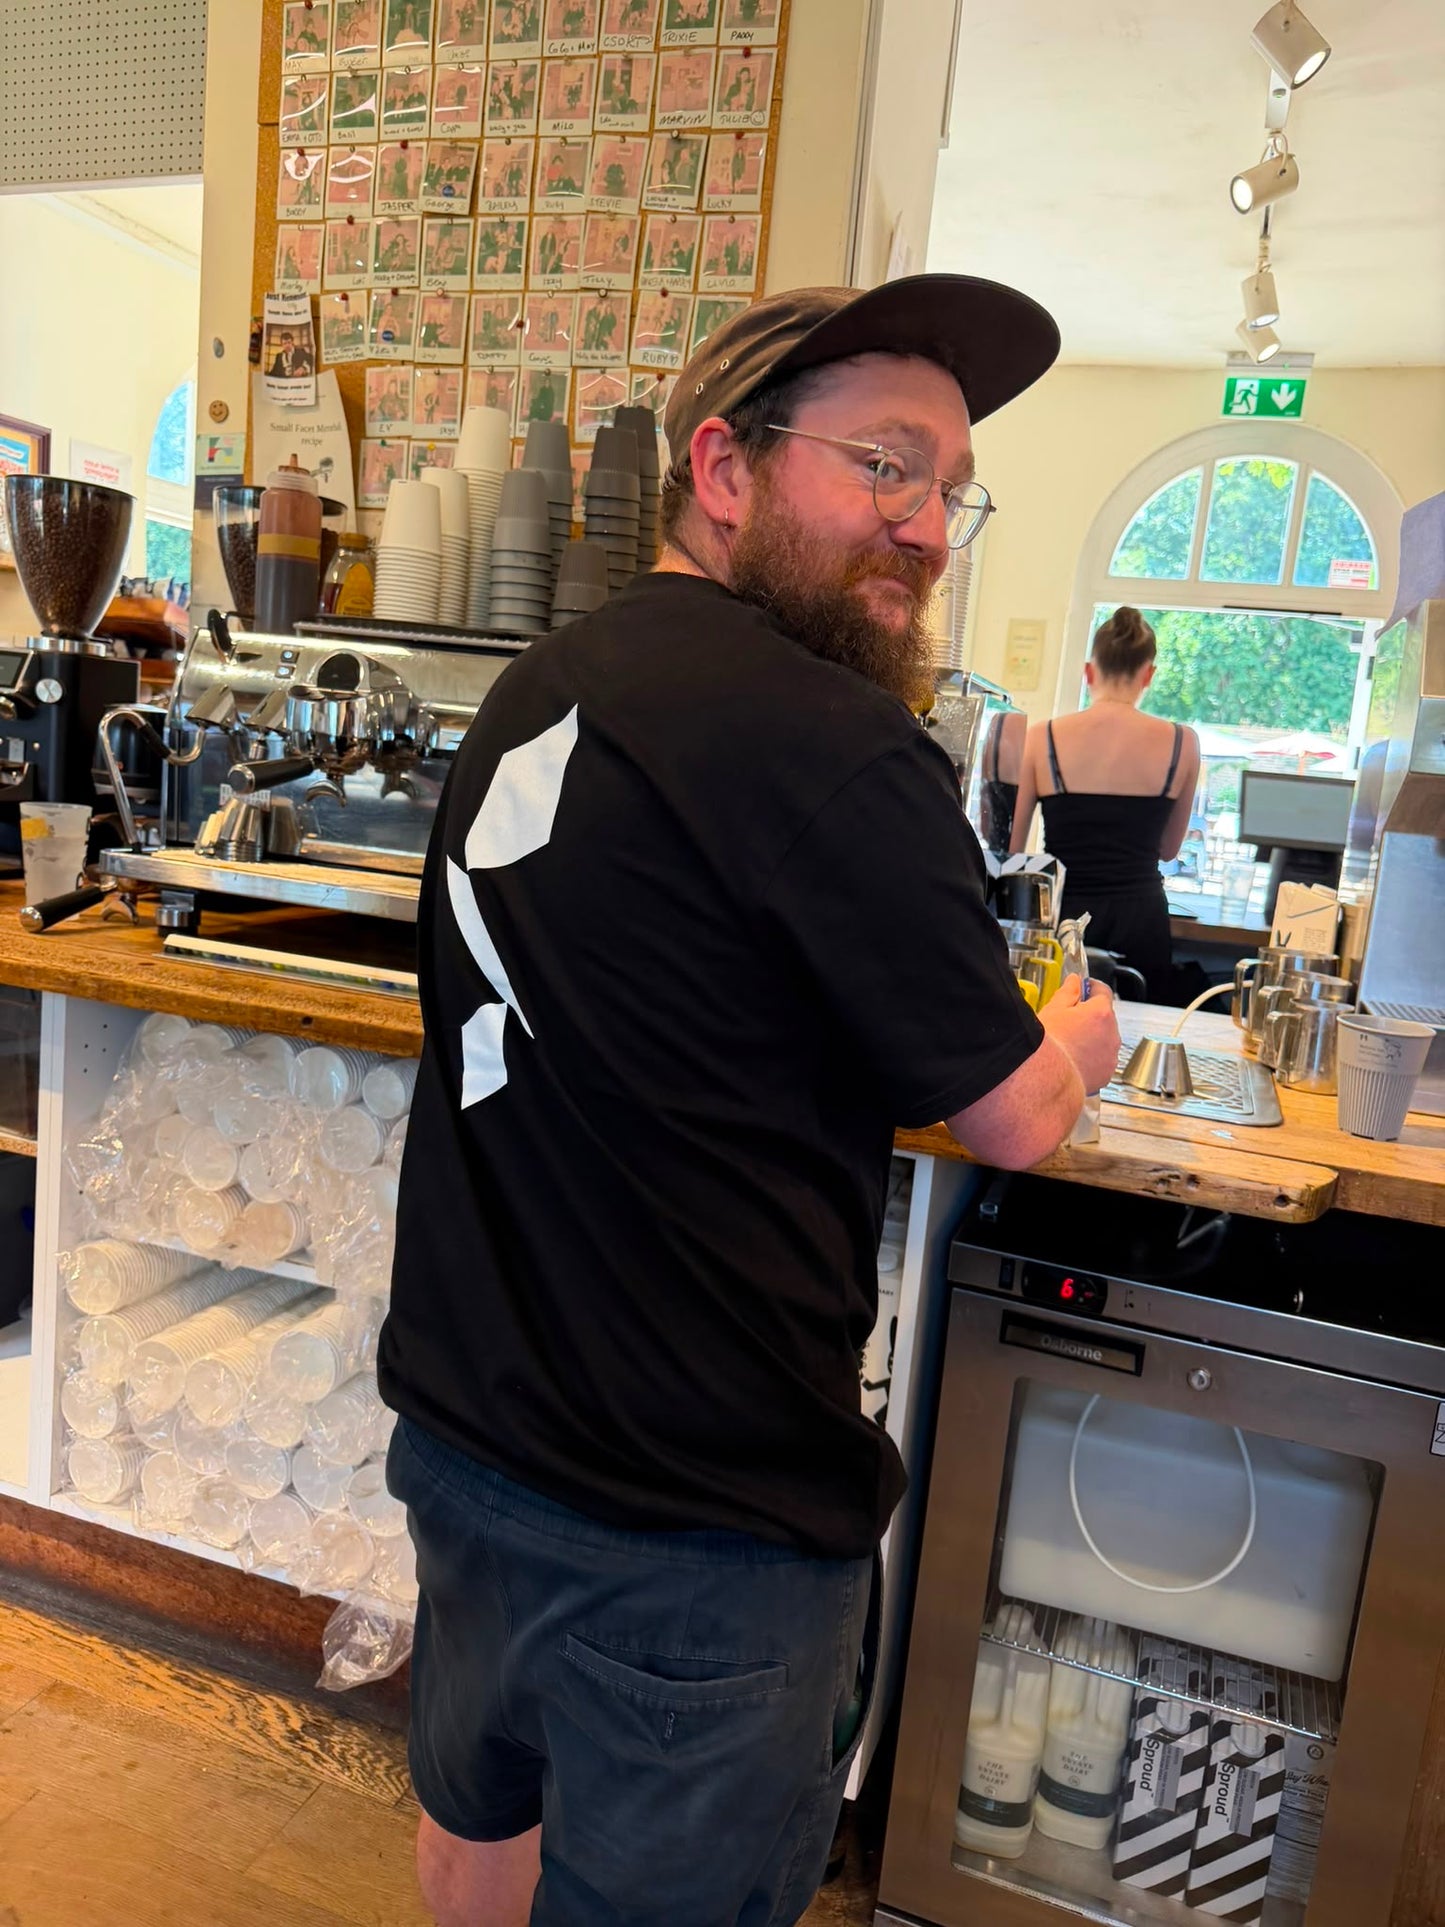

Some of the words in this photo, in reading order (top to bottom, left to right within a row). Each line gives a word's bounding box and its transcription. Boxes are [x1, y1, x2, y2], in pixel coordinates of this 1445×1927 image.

[662, 31, 697, 43] TRIXIE
[380, 202, 416, 213] JASPER
[590, 197, 621, 210] STEVIE
[642, 352, 669, 365] RUBY
[1060, 1277, 1075, 1299] 6
[1040, 1335, 1103, 1361] Osborne
[1140, 1737, 1160, 1792] Sproud
[1214, 1761, 1236, 1817] Sproud
